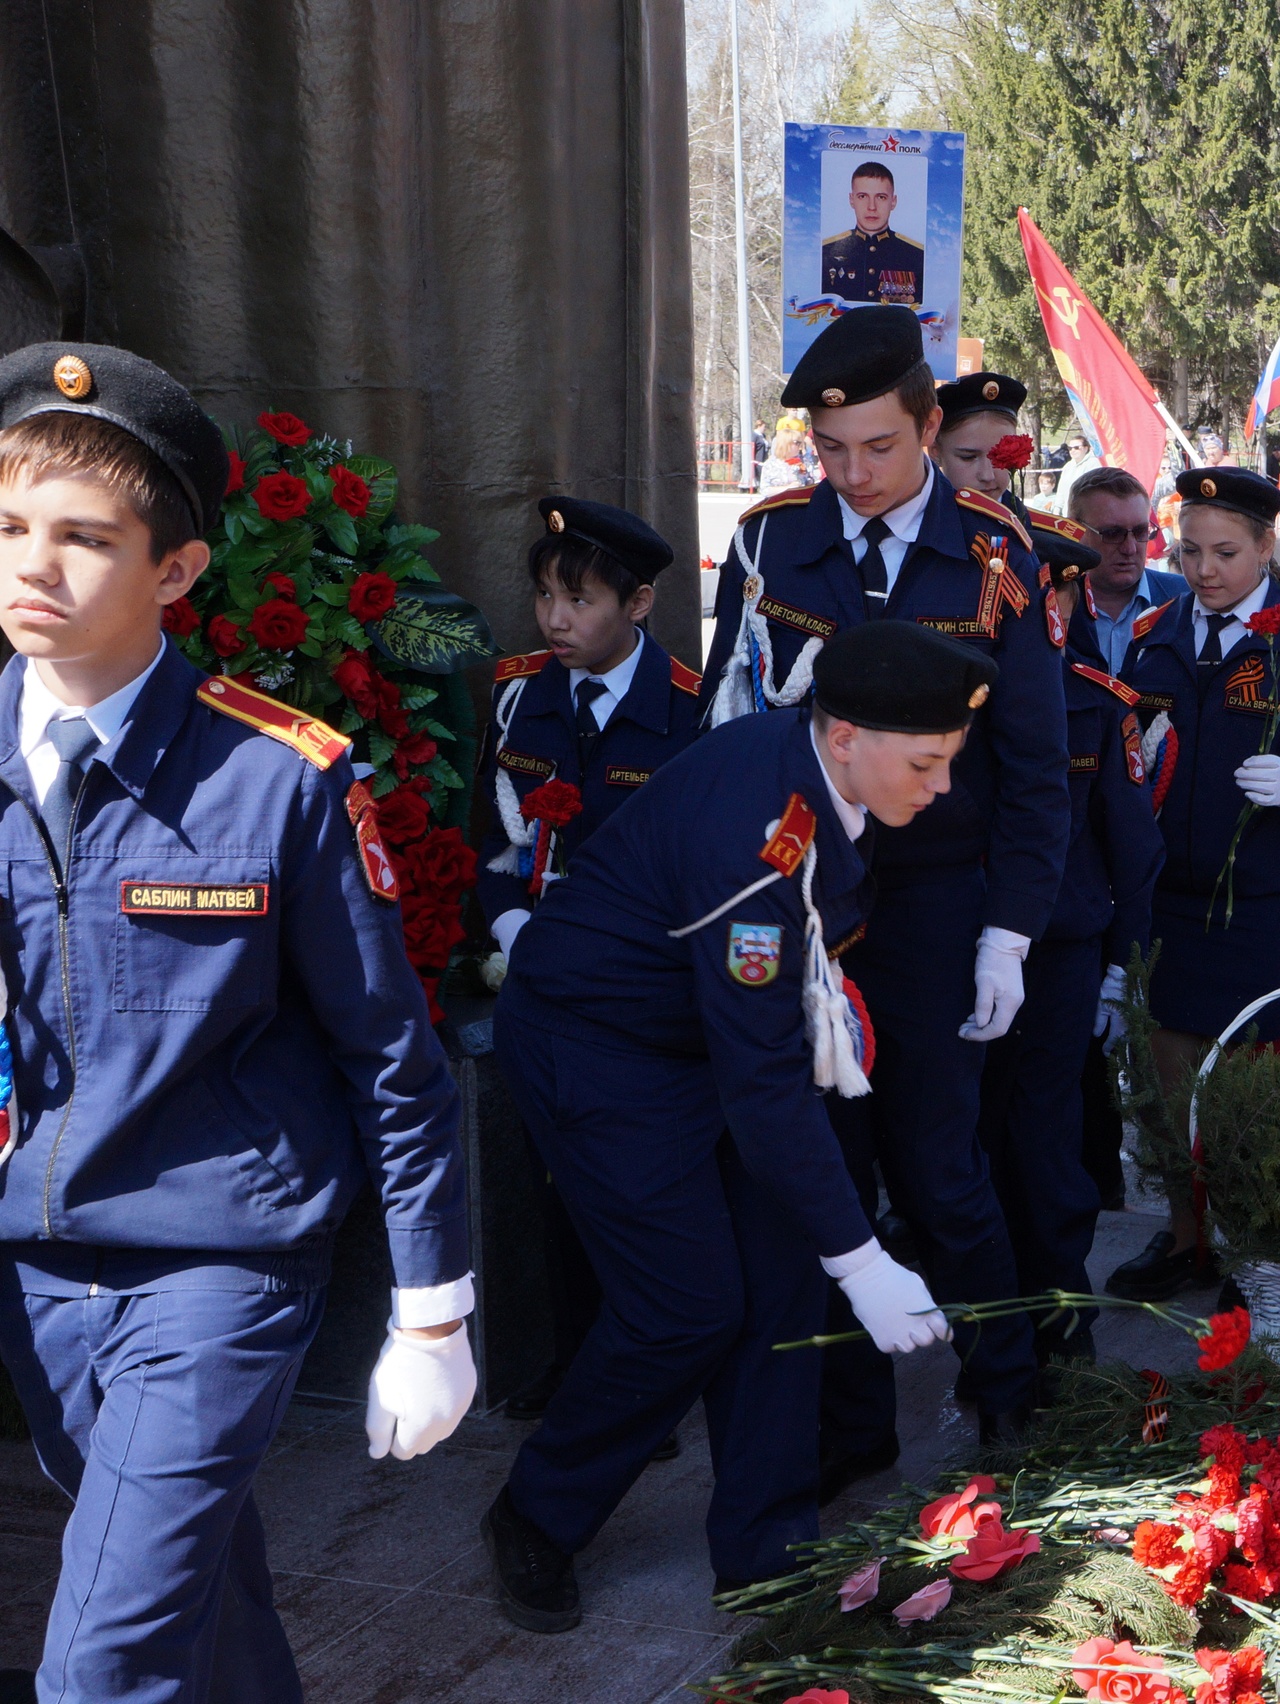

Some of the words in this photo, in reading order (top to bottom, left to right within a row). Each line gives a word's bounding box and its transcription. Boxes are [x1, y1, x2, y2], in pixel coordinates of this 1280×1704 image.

[760, 600, 807, 626] КАДЕТСКИЙ
[806, 619, 832, 636] КЛАСС
[499, 751, 536, 771] КАДЕТСКИЙ
[1071, 757, 1095, 768] ПАВЕЛ
[131, 888, 191, 907] САБЛИН
[197, 888, 256, 908] МАТВЕЙ
